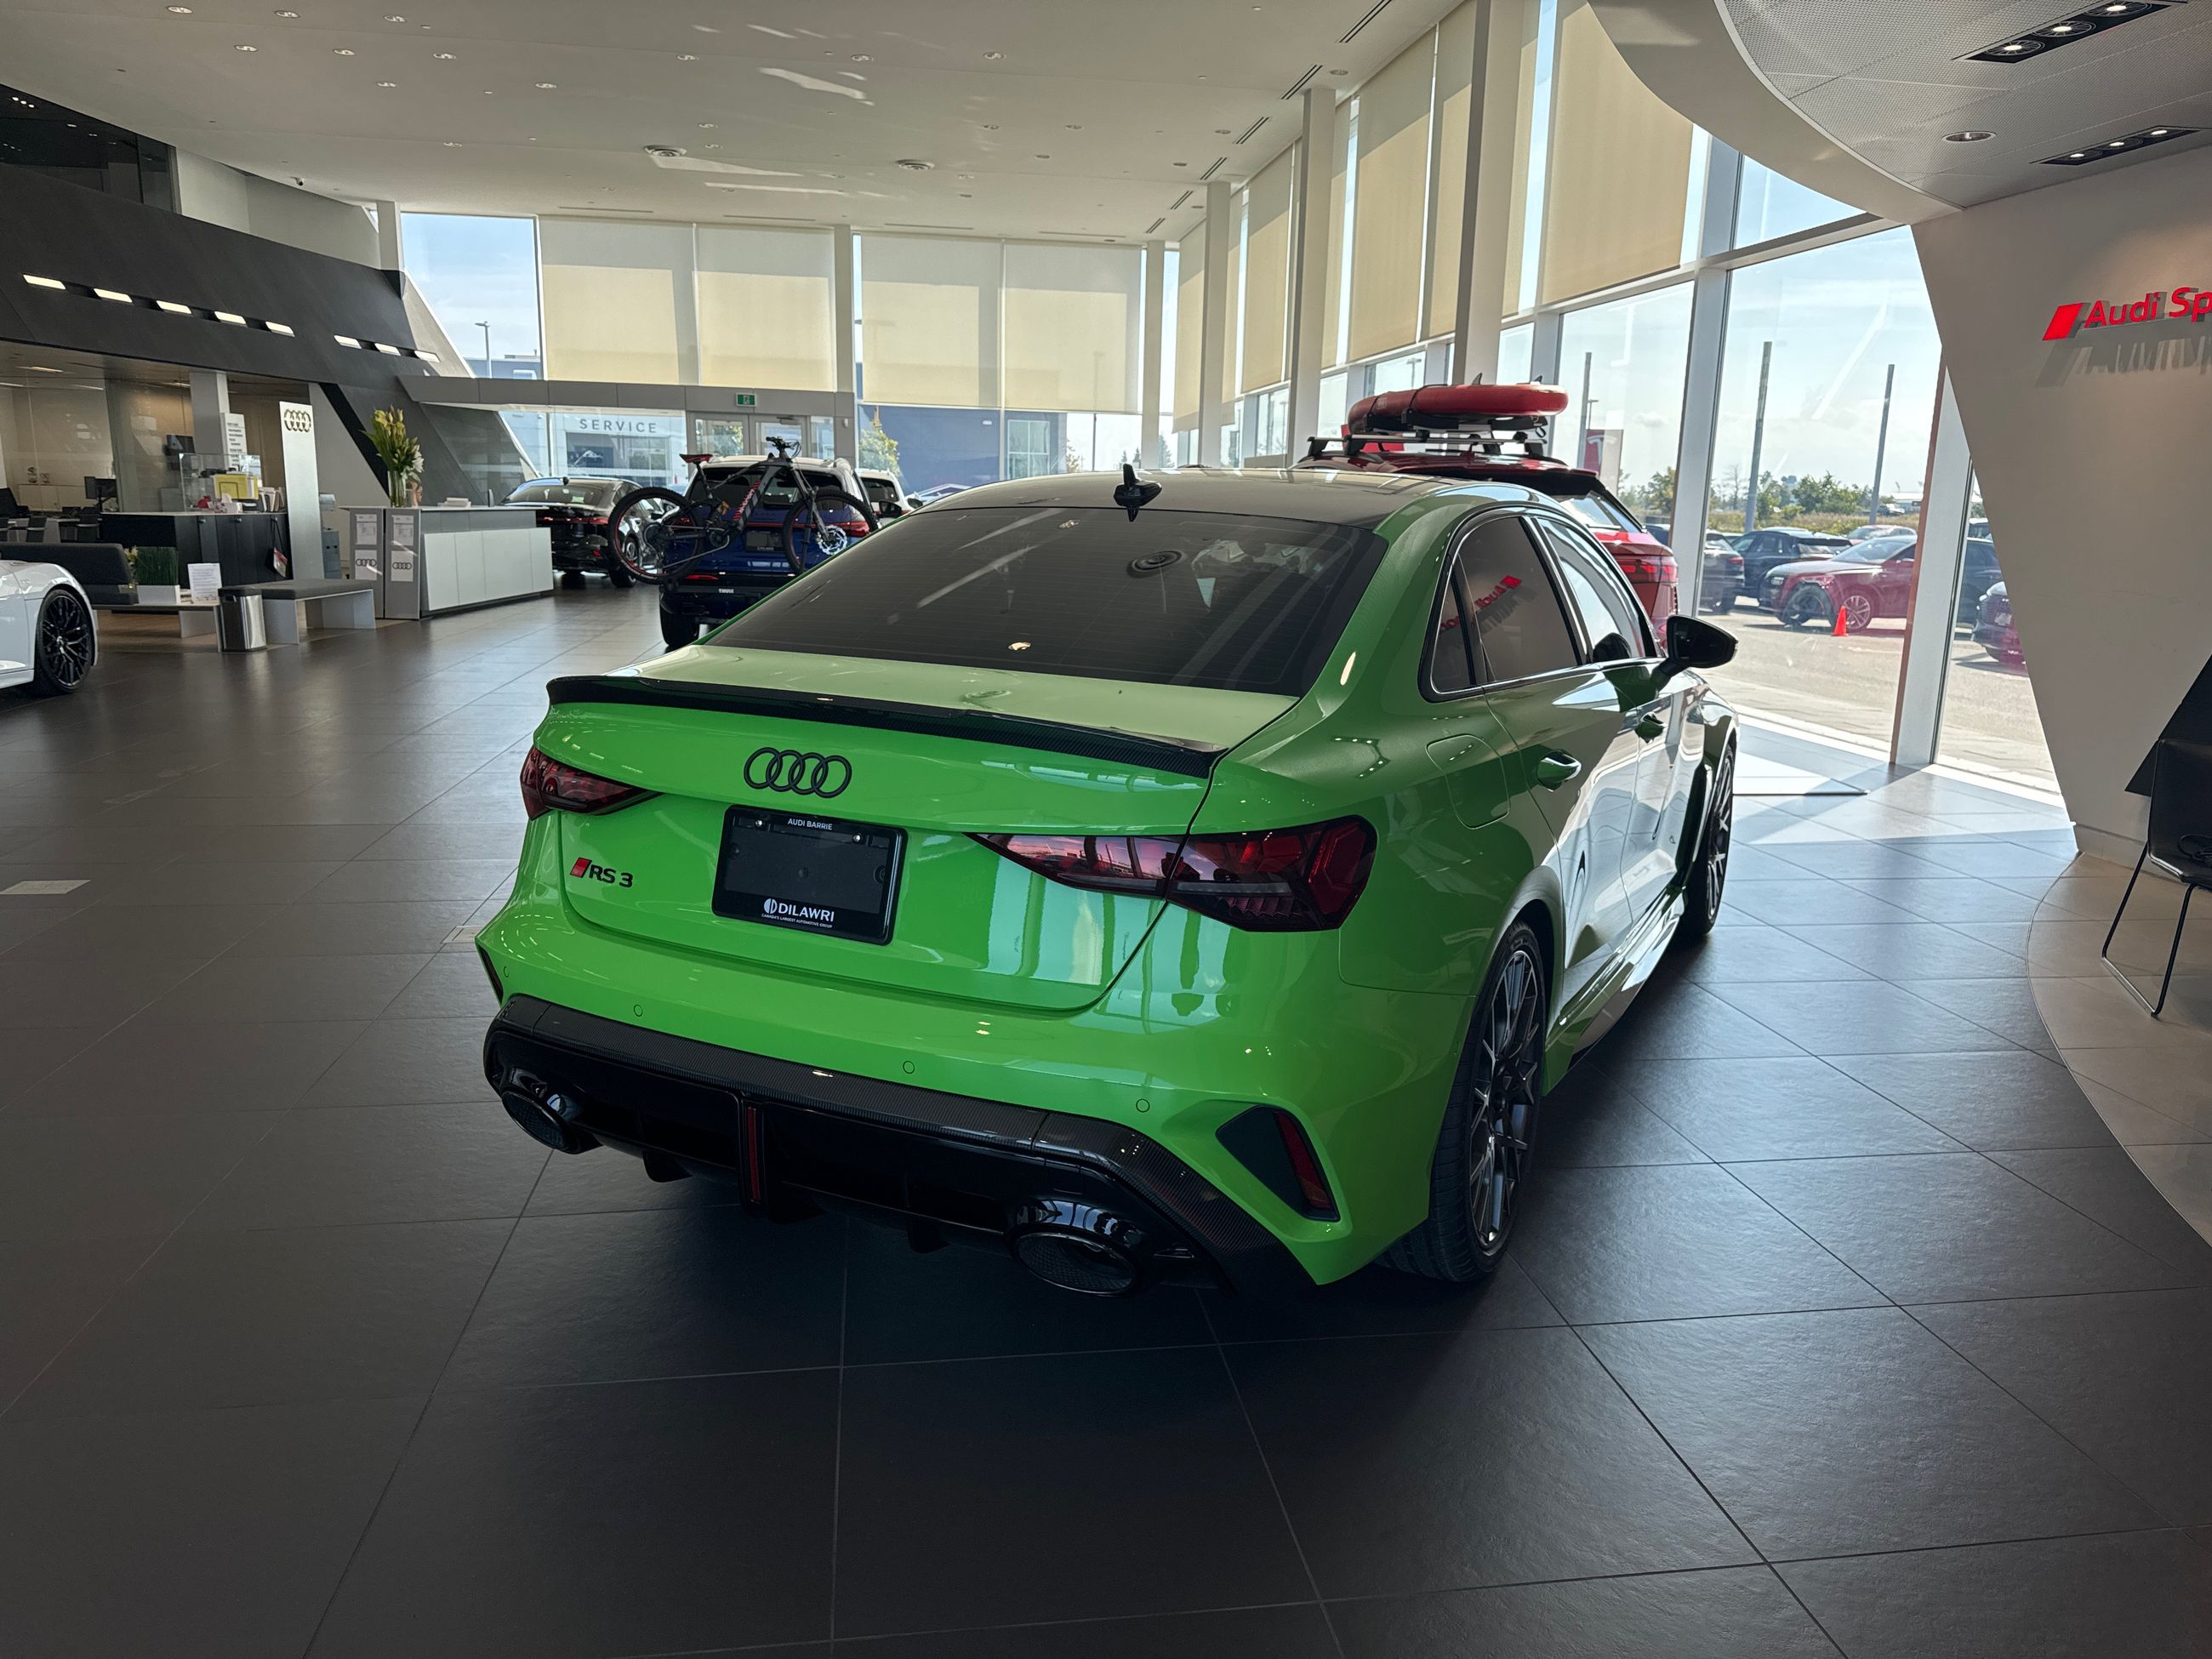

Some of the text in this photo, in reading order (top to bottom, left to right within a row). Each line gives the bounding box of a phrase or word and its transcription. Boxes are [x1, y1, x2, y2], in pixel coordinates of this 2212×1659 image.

[2084, 292, 2163, 328] Audi
[579, 419, 656, 433] SERVICE
[787, 818, 833, 830] AUDI BARRIE
[589, 864, 633, 888] RS 3
[778, 903, 835, 922] DILAWRI
